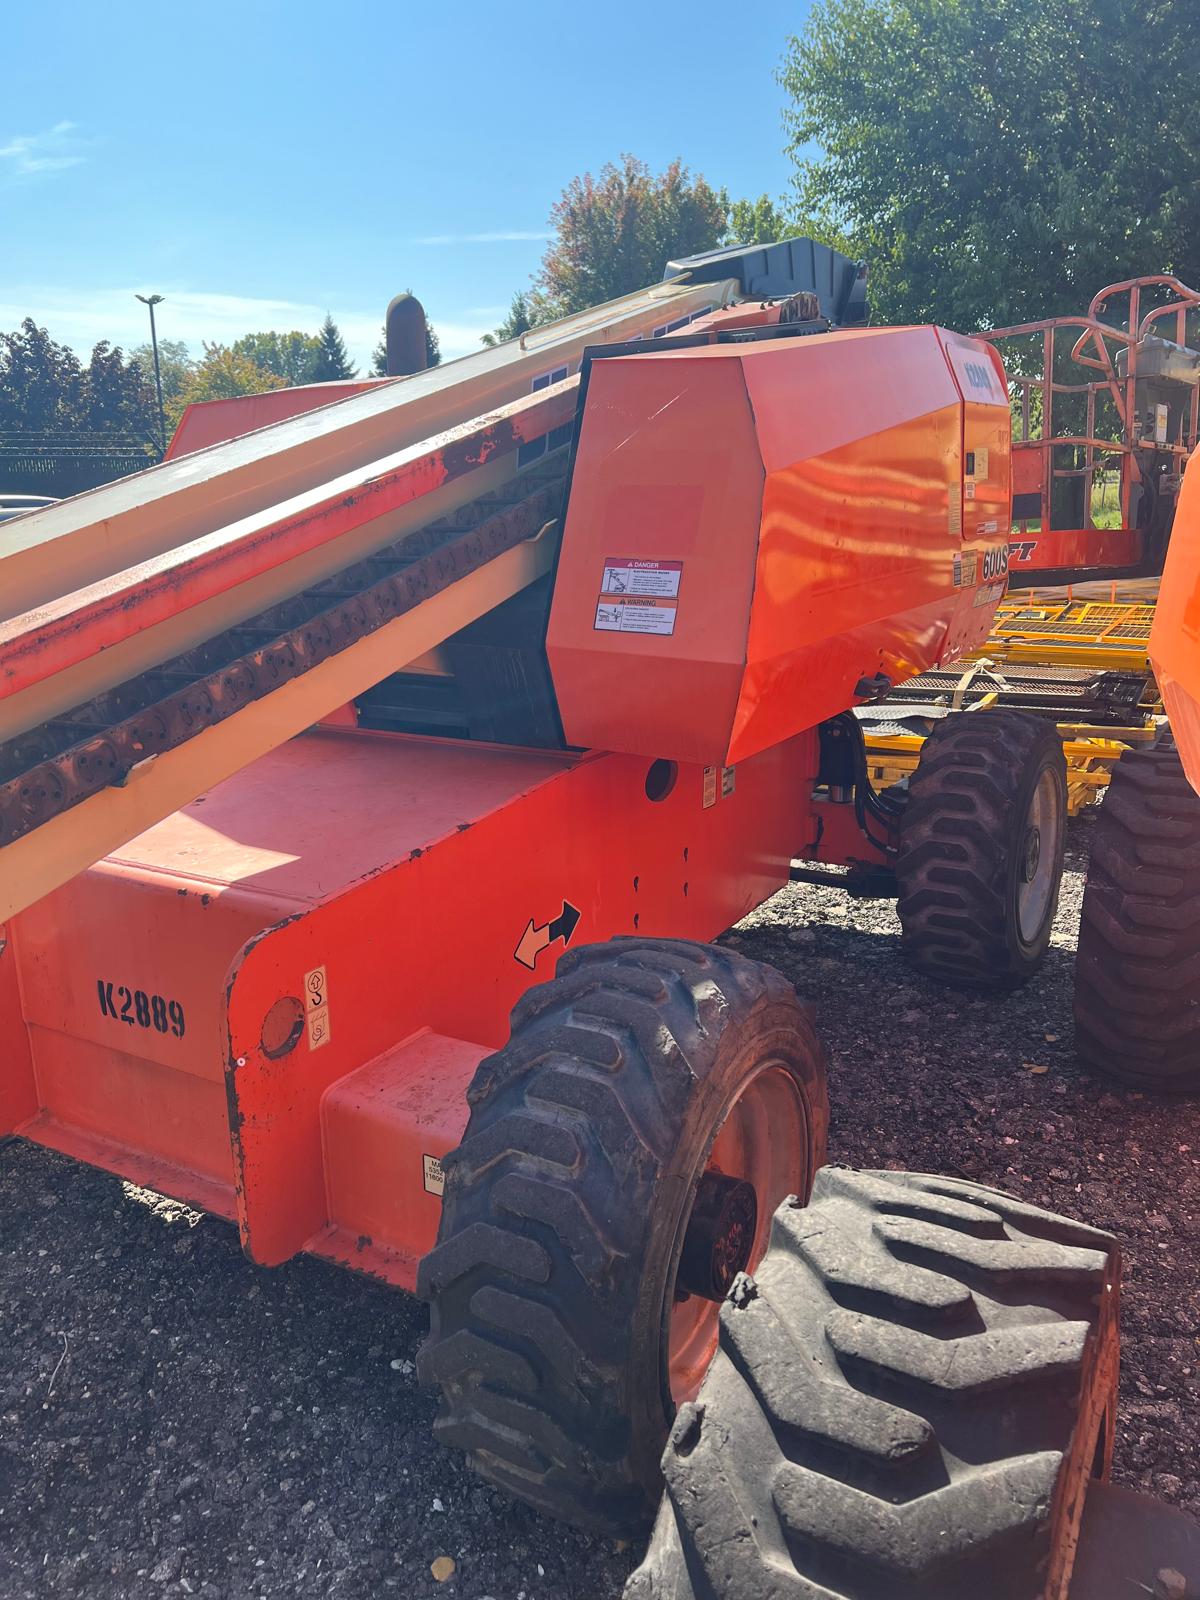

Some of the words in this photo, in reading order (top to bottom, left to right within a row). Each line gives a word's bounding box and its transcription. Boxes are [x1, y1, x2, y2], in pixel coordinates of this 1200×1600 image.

[983, 543, 1008, 581] 600S
[626, 599, 656, 607] WARNING
[97, 979, 186, 1038] K2889
